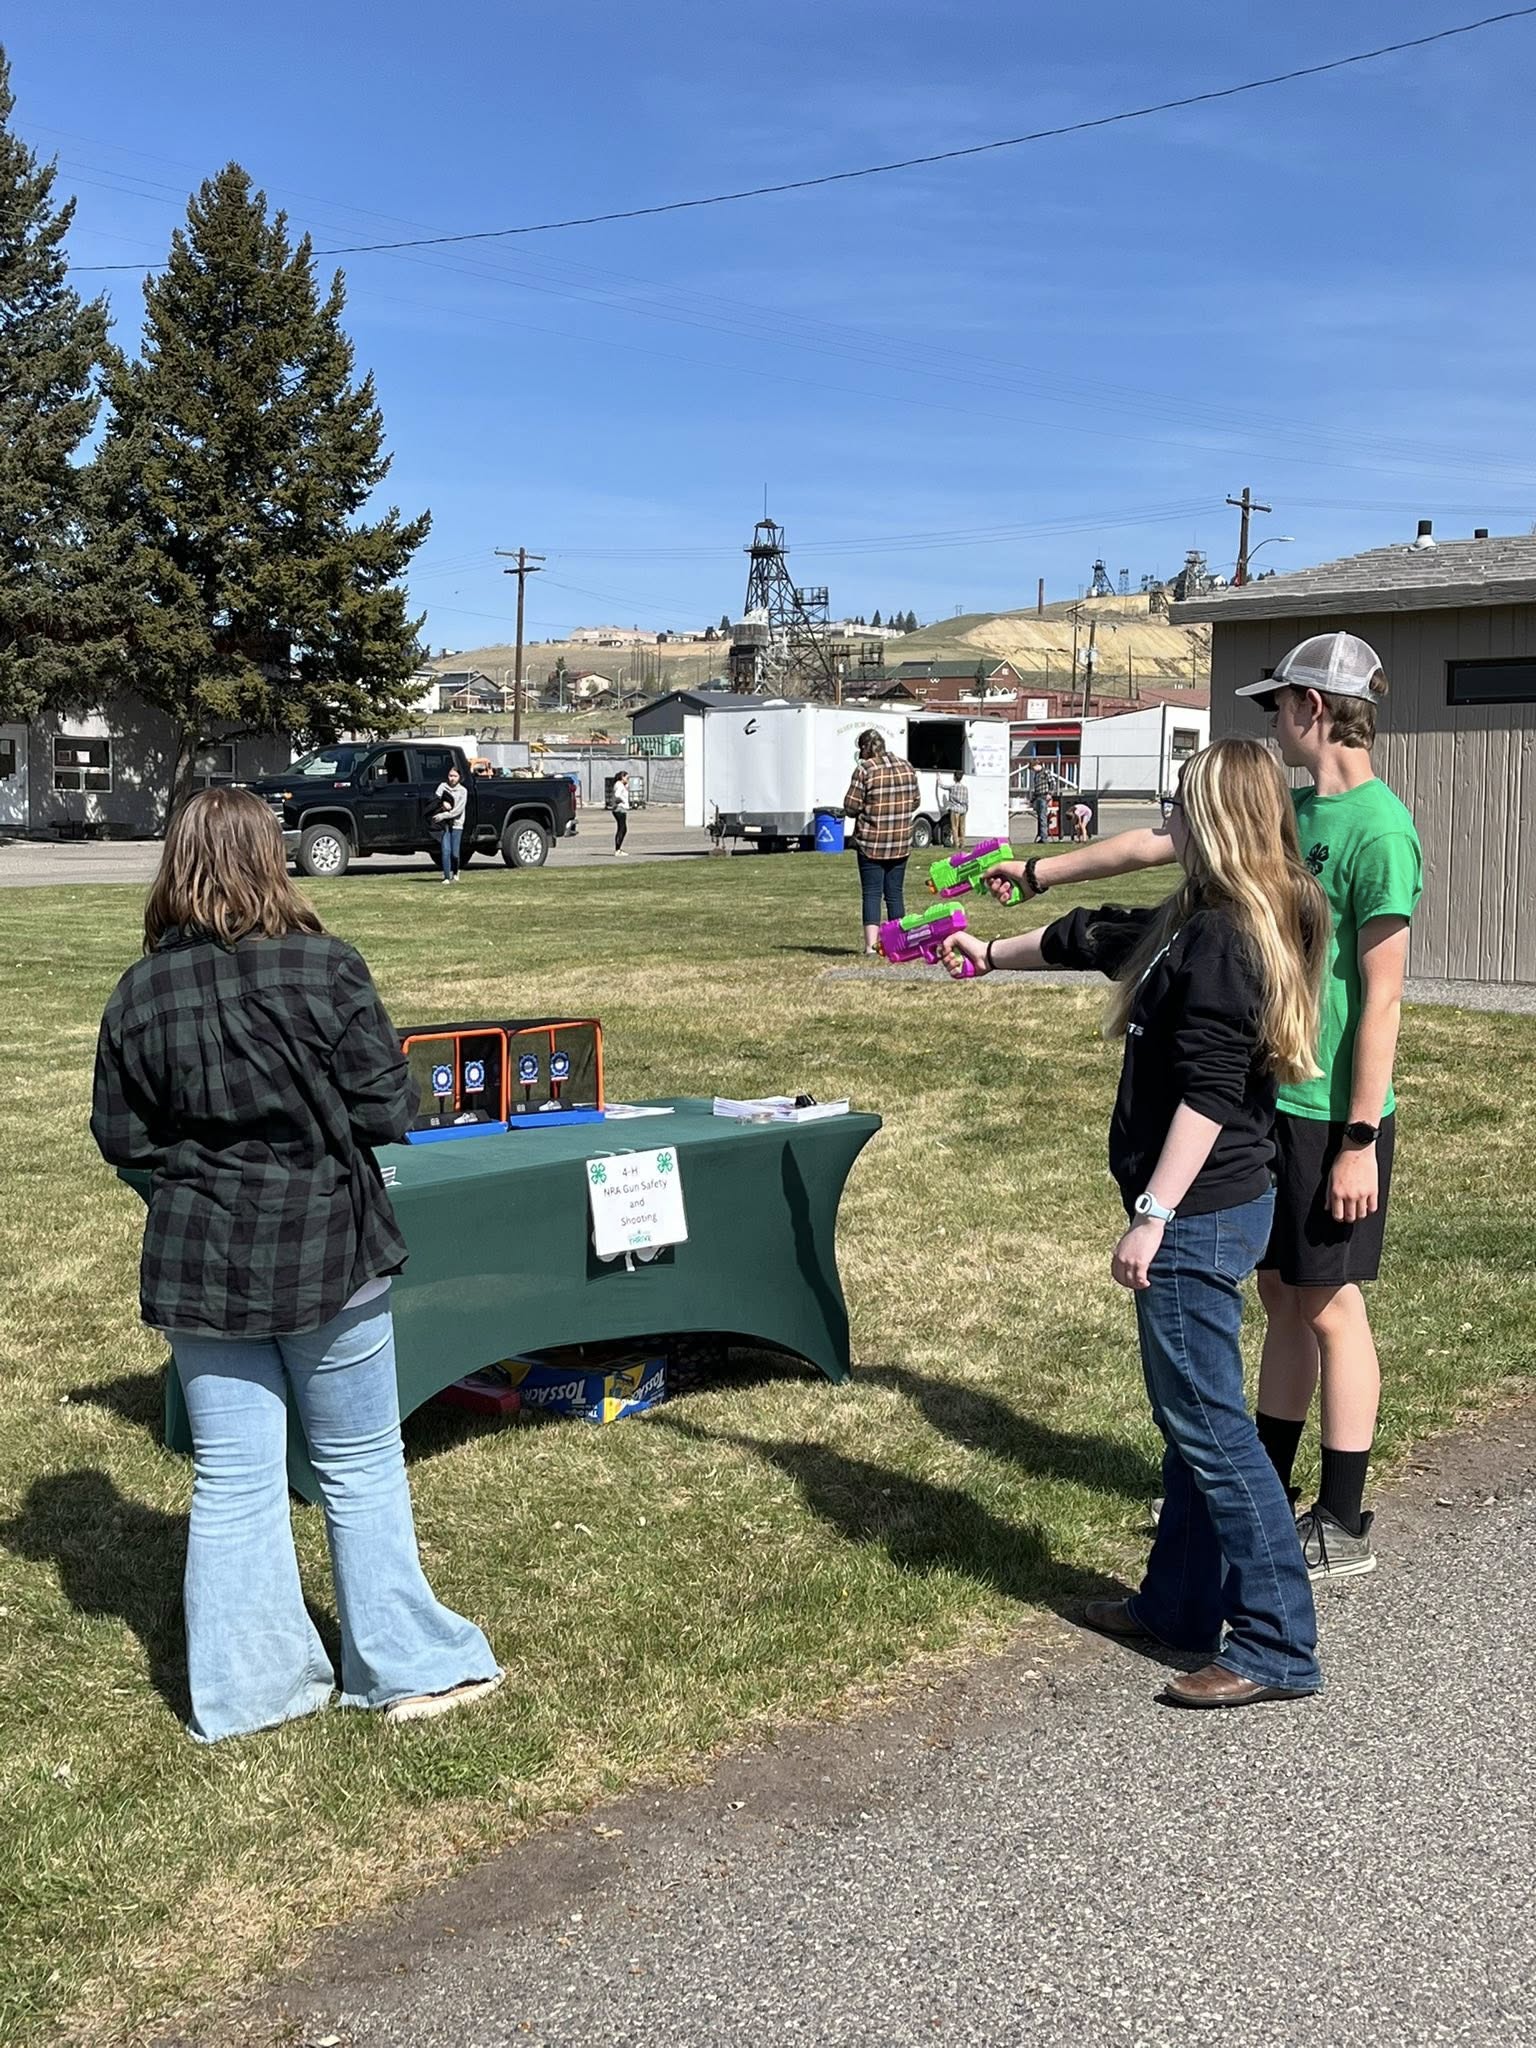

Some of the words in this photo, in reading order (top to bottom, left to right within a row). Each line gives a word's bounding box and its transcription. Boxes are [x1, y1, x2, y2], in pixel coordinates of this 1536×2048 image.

[1127, 1022, 1144, 1036] TS
[622, 1166, 638, 1176] 4-H
[604, 1186, 621, 1197] NRA
[622, 1184, 640, 1194] Gun
[640, 1178, 667, 1191] Safety
[629, 1198, 645, 1209] and
[620, 1213, 658, 1227] Shooting
